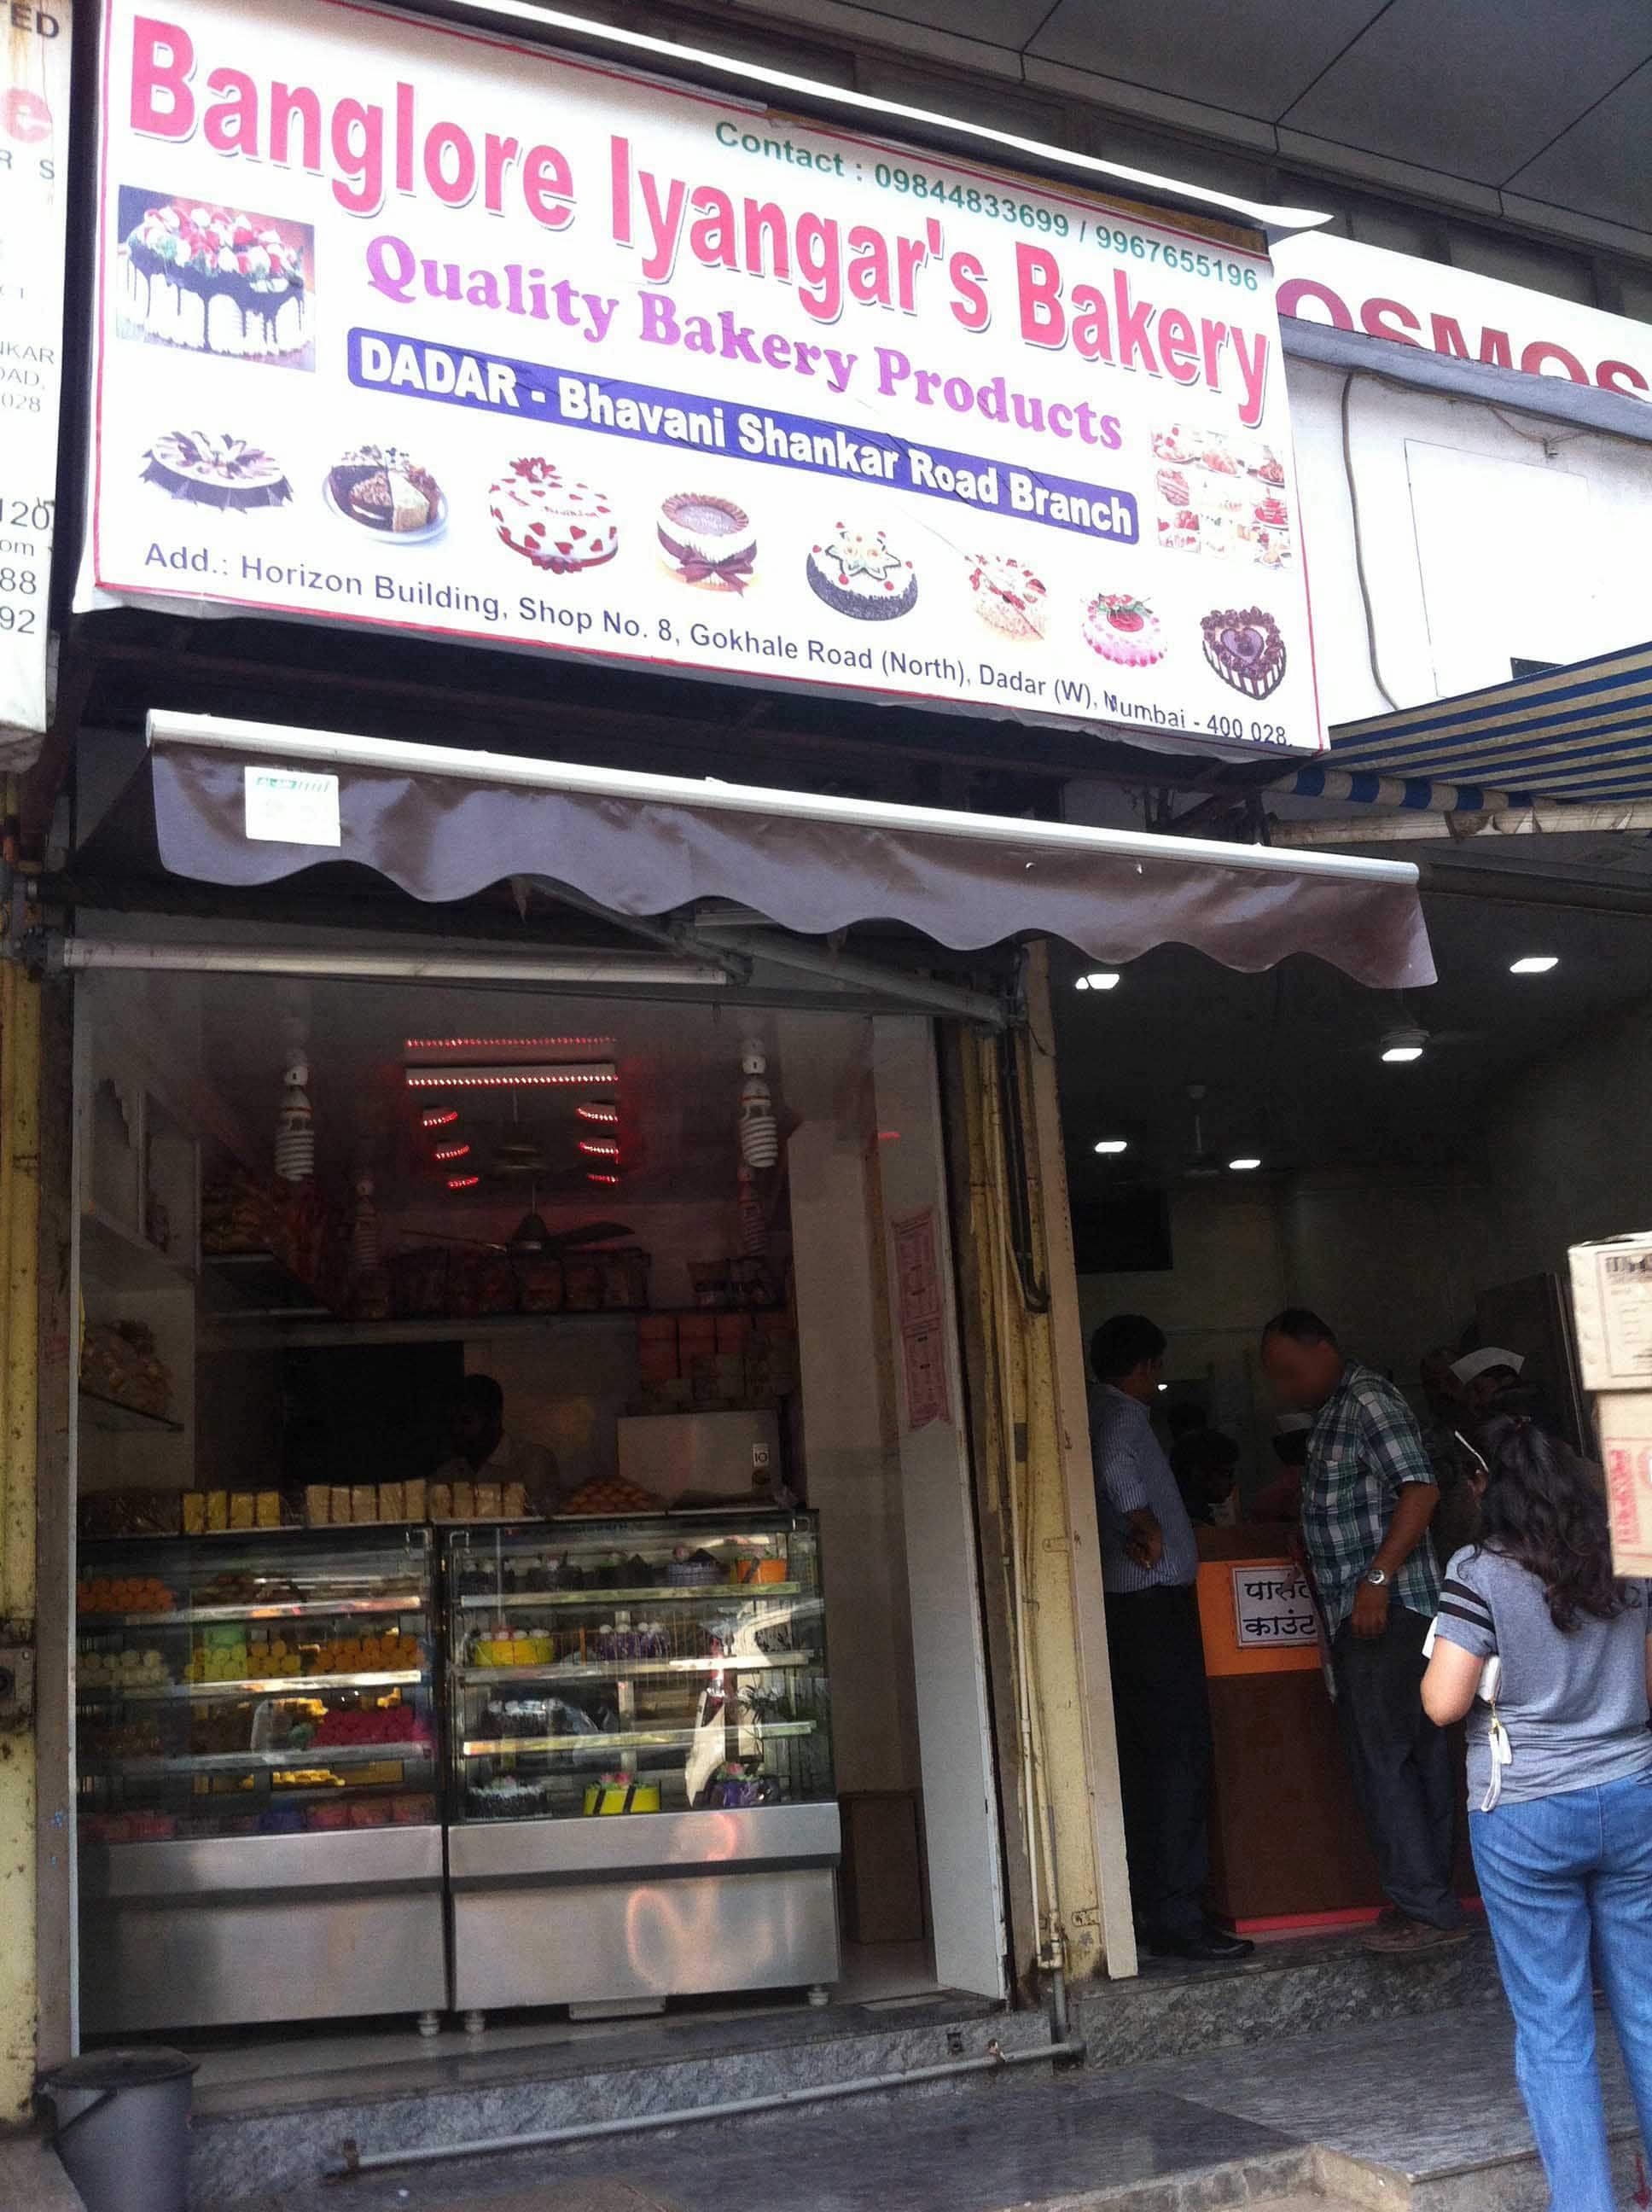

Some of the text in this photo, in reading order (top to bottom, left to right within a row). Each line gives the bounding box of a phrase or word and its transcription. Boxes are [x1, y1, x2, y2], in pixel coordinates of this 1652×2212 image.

[0, 0, 59, 38] ED
[130, 15, 1270, 428] Banglore Iyangar's Bakery
[715, 120, 845, 176] Contact
[875, 162, 1069, 238] 09844833699
[1096, 224, 1259, 292] 9967655196
[360, 339, 519, 408] DADAR
[559, 375, 726, 449] Bhavani
[736, 413, 900, 481] Shankar
[907, 455, 999, 506] Road
[1009, 473, 1134, 537] Branch
[365, 234, 1124, 451] Quality Bakery Products
[241, 556, 364, 597] Horizon
[374, 576, 509, 621] Building,
[518, 597, 593, 633] Shop
[602, 609, 649, 638] No.
[657, 618, 681, 646] 8,
[689, 623, 799, 660] Gokhale
[807, 640, 873, 672] Road
[881, 648, 972, 687] (North),
[979, 665, 1047, 697] Dadar
[1054, 678, 1098, 710] (W),
[1207, 714, 1243, 740] 400
